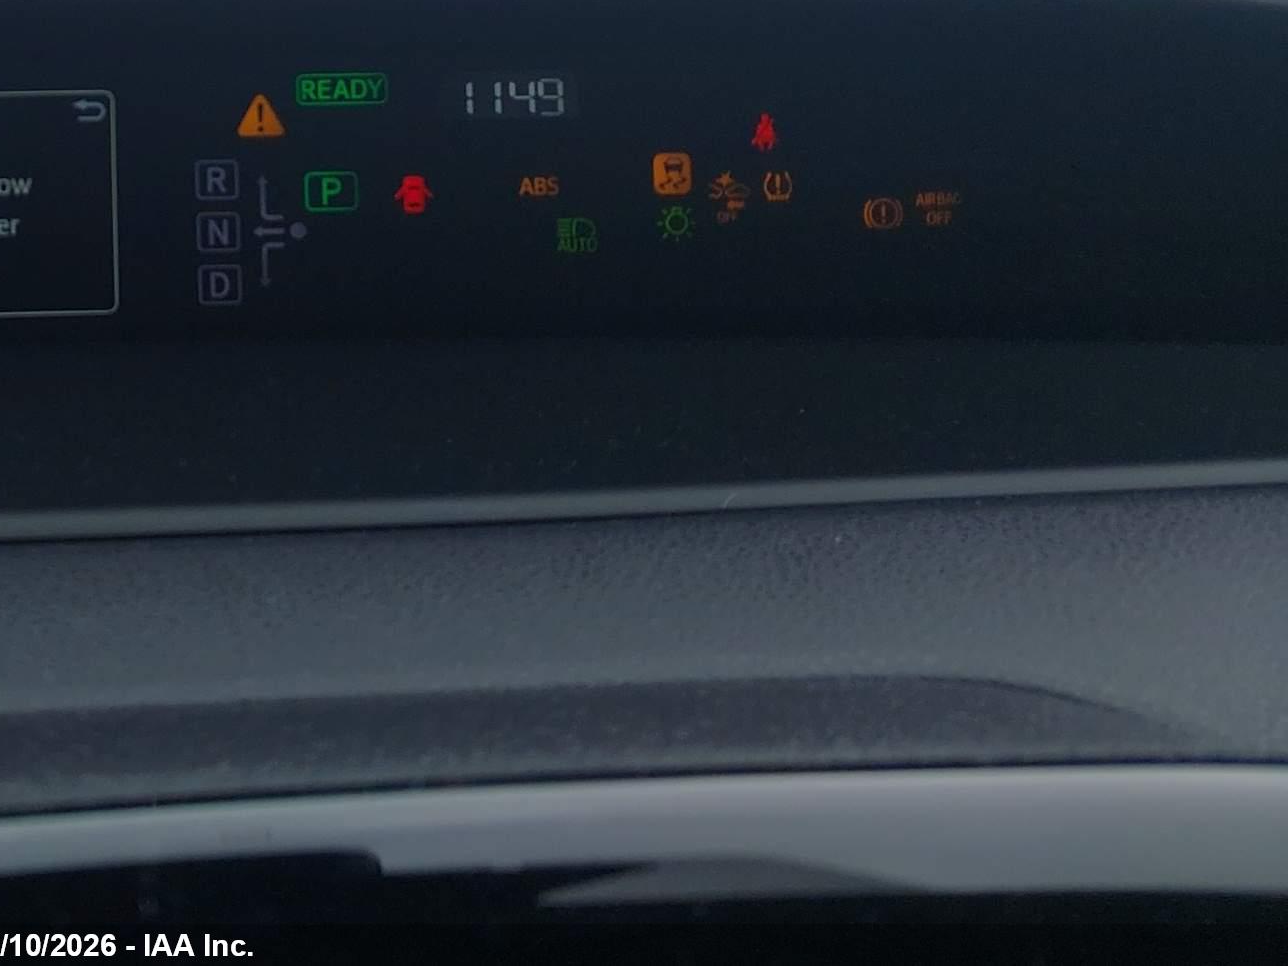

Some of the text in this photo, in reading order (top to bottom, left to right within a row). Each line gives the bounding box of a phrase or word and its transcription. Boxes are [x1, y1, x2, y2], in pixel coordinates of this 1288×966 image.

[302, 78, 383, 100] READY
[464, 78, 565, 117] 1149
[206, 167, 226, 193] R
[321, 177, 343, 205] P
[518, 177, 560, 196] ABS
[925, 210, 953, 226] OFF
[208, 219, 229, 246] N
[557, 236, 598, 254] AUTO
[211, 272, 231, 299] D
